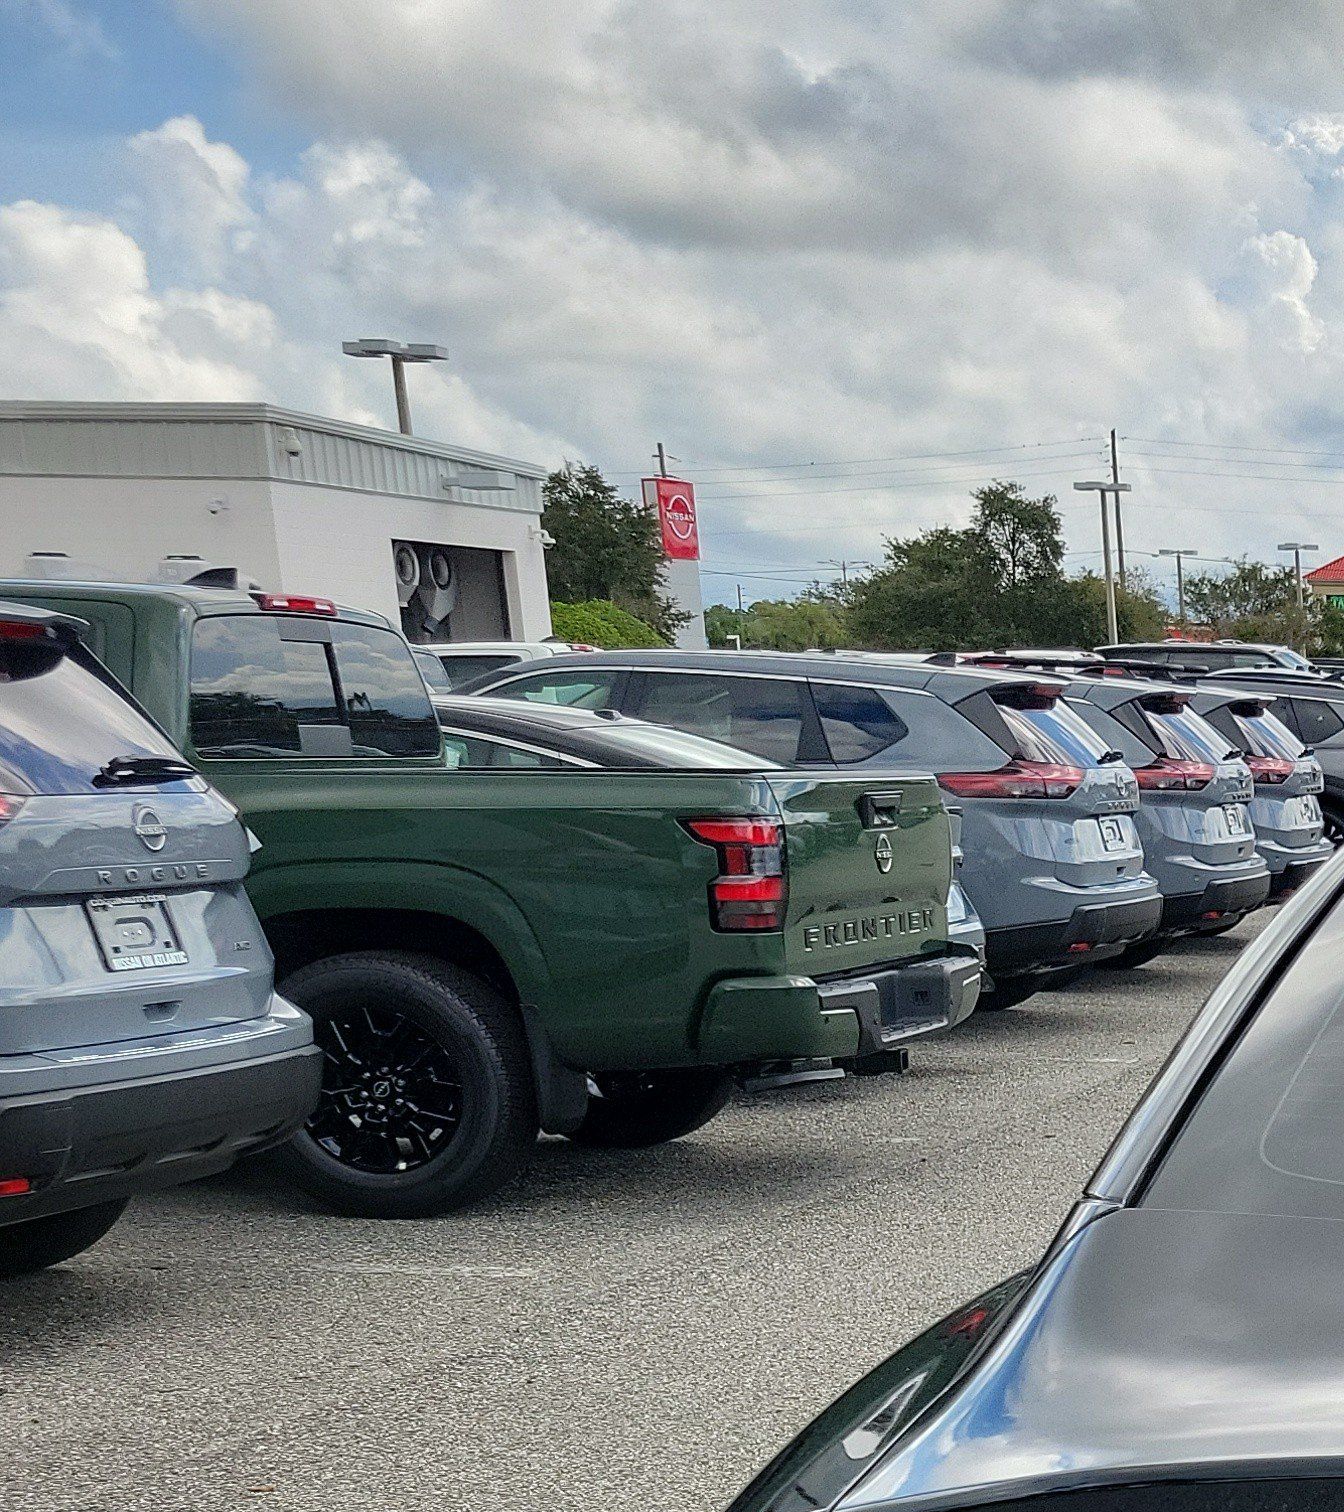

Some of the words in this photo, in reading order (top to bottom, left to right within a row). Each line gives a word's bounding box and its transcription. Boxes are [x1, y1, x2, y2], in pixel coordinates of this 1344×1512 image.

[666, 511, 695, 522] NISSAN
[97, 864, 209, 885] ROGUE
[803, 908, 934, 952] FRONTIER
